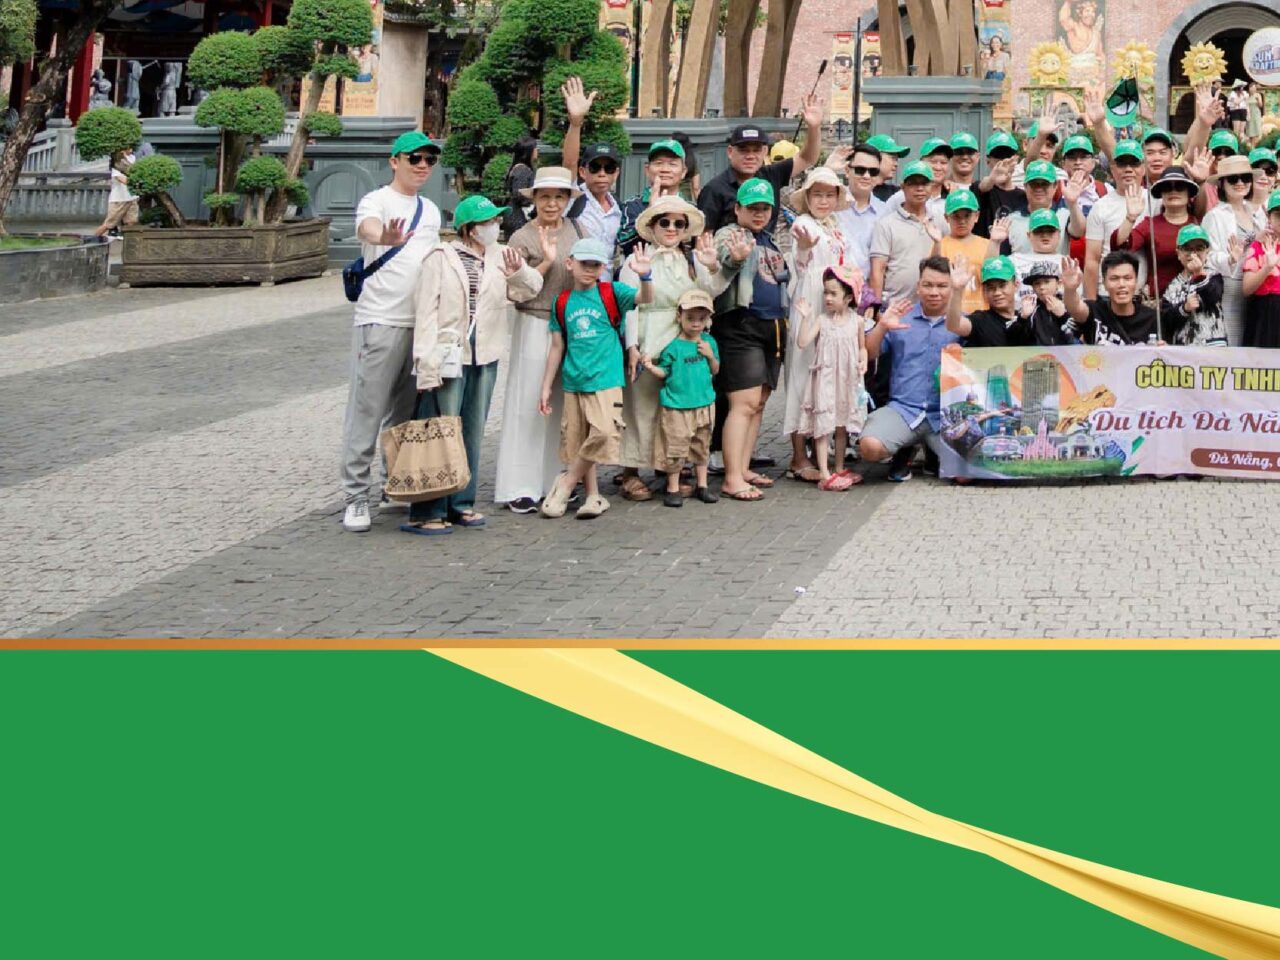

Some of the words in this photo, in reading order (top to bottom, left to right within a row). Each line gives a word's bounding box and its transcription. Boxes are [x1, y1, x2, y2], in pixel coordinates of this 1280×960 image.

[1135, 358, 1195, 389] CÔNG
[1200, 366, 1228, 391] TY
[1093, 410, 1131, 432] Du
[1138, 410, 1185, 436] lịch
[1192, 410, 1232, 432] Đà
[1208, 451, 1229, 465] Đà
